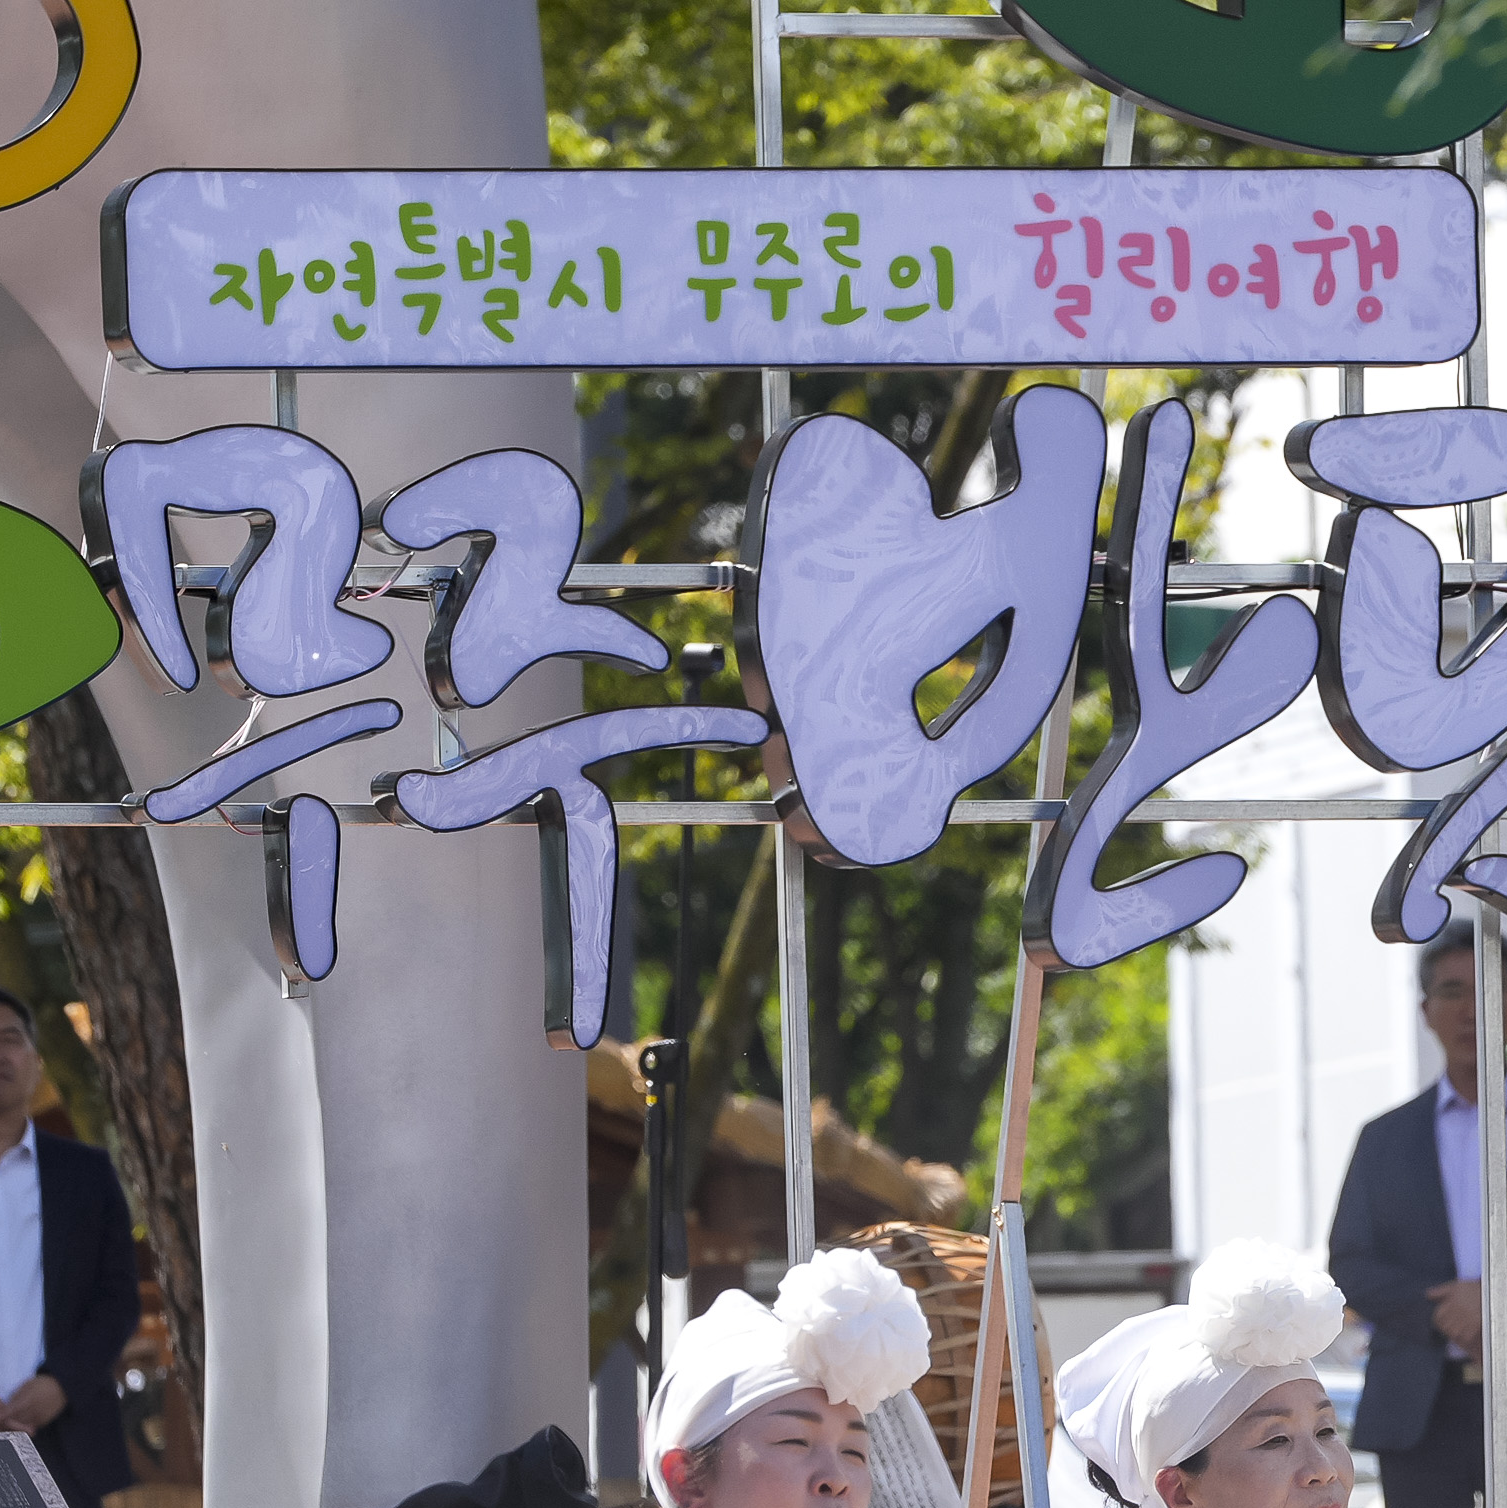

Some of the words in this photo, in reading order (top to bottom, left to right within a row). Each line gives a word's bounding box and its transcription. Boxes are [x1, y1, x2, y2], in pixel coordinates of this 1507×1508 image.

[209, 201, 624, 344] 자연특별시
[686, 211, 956, 326] 무주로의
[1012, 192, 1401, 340] 힐링여행
